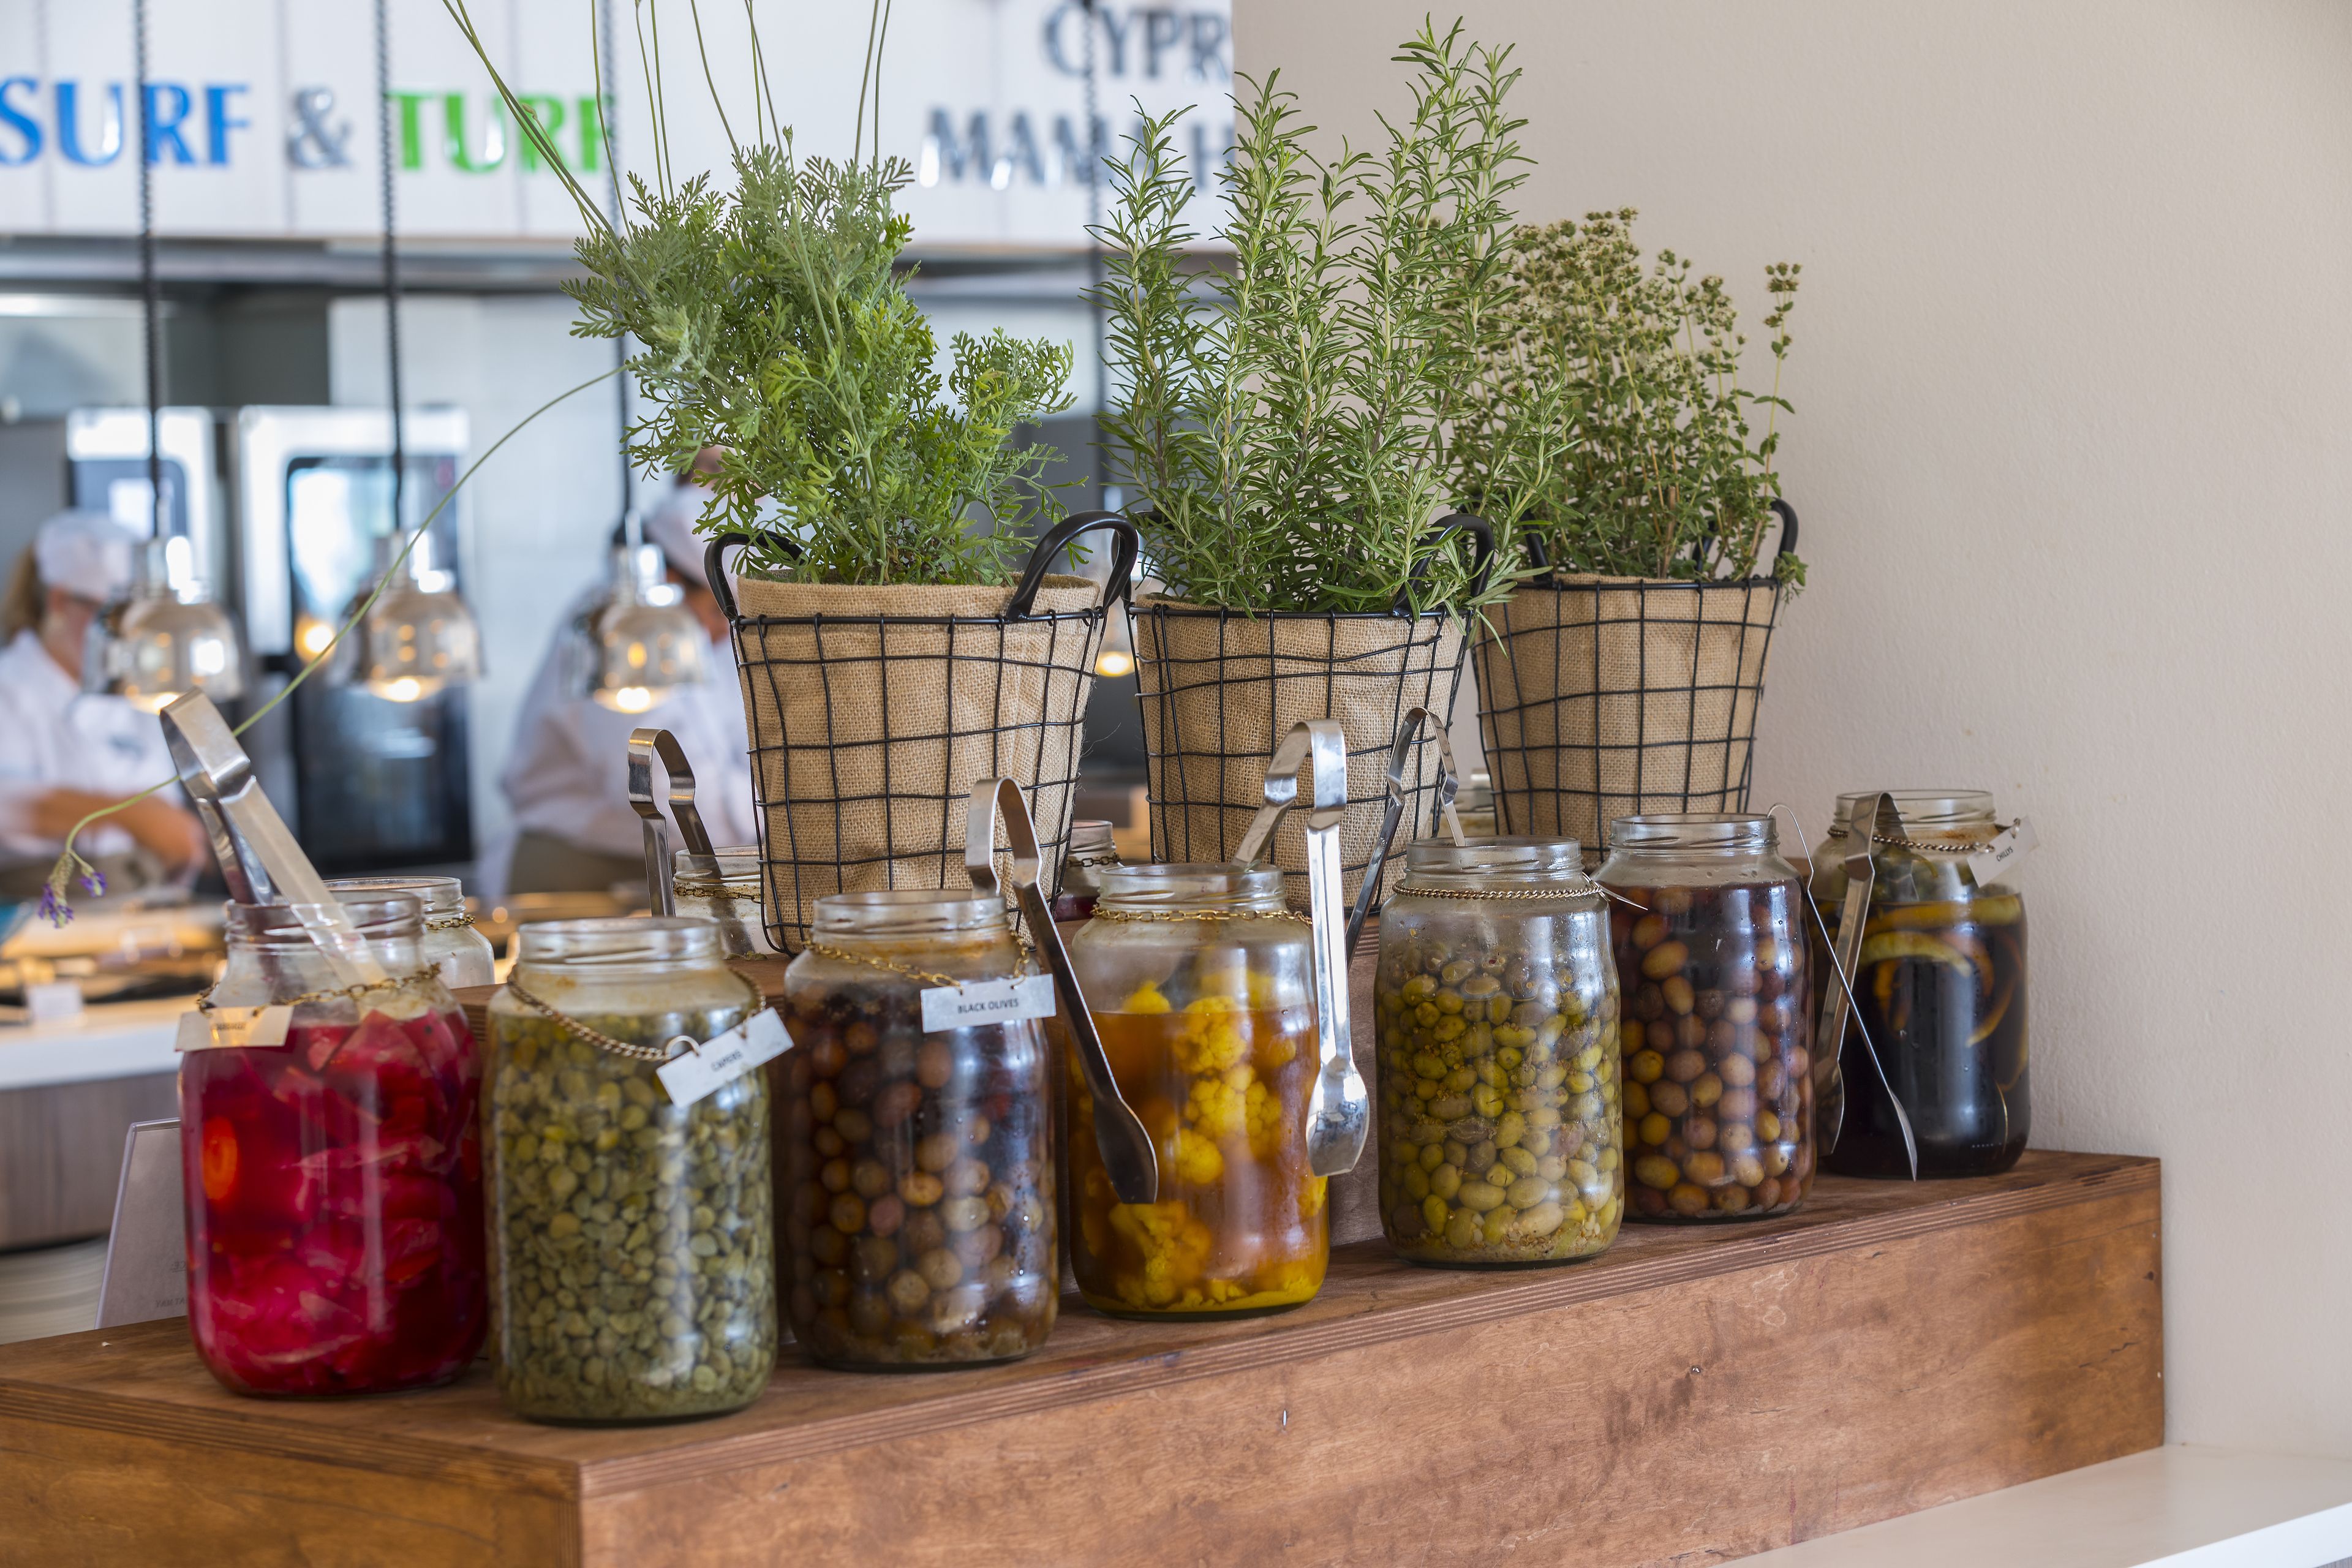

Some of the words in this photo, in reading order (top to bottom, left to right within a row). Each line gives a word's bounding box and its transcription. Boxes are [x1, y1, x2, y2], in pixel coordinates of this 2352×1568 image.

[0, 78, 249, 168] SURF
[288, 87, 352, 170] &
[386, 91, 616, 173] TURF
[957, 1003, 986, 1014] BLACK
[988, 998, 1019, 1011] OLIVES
